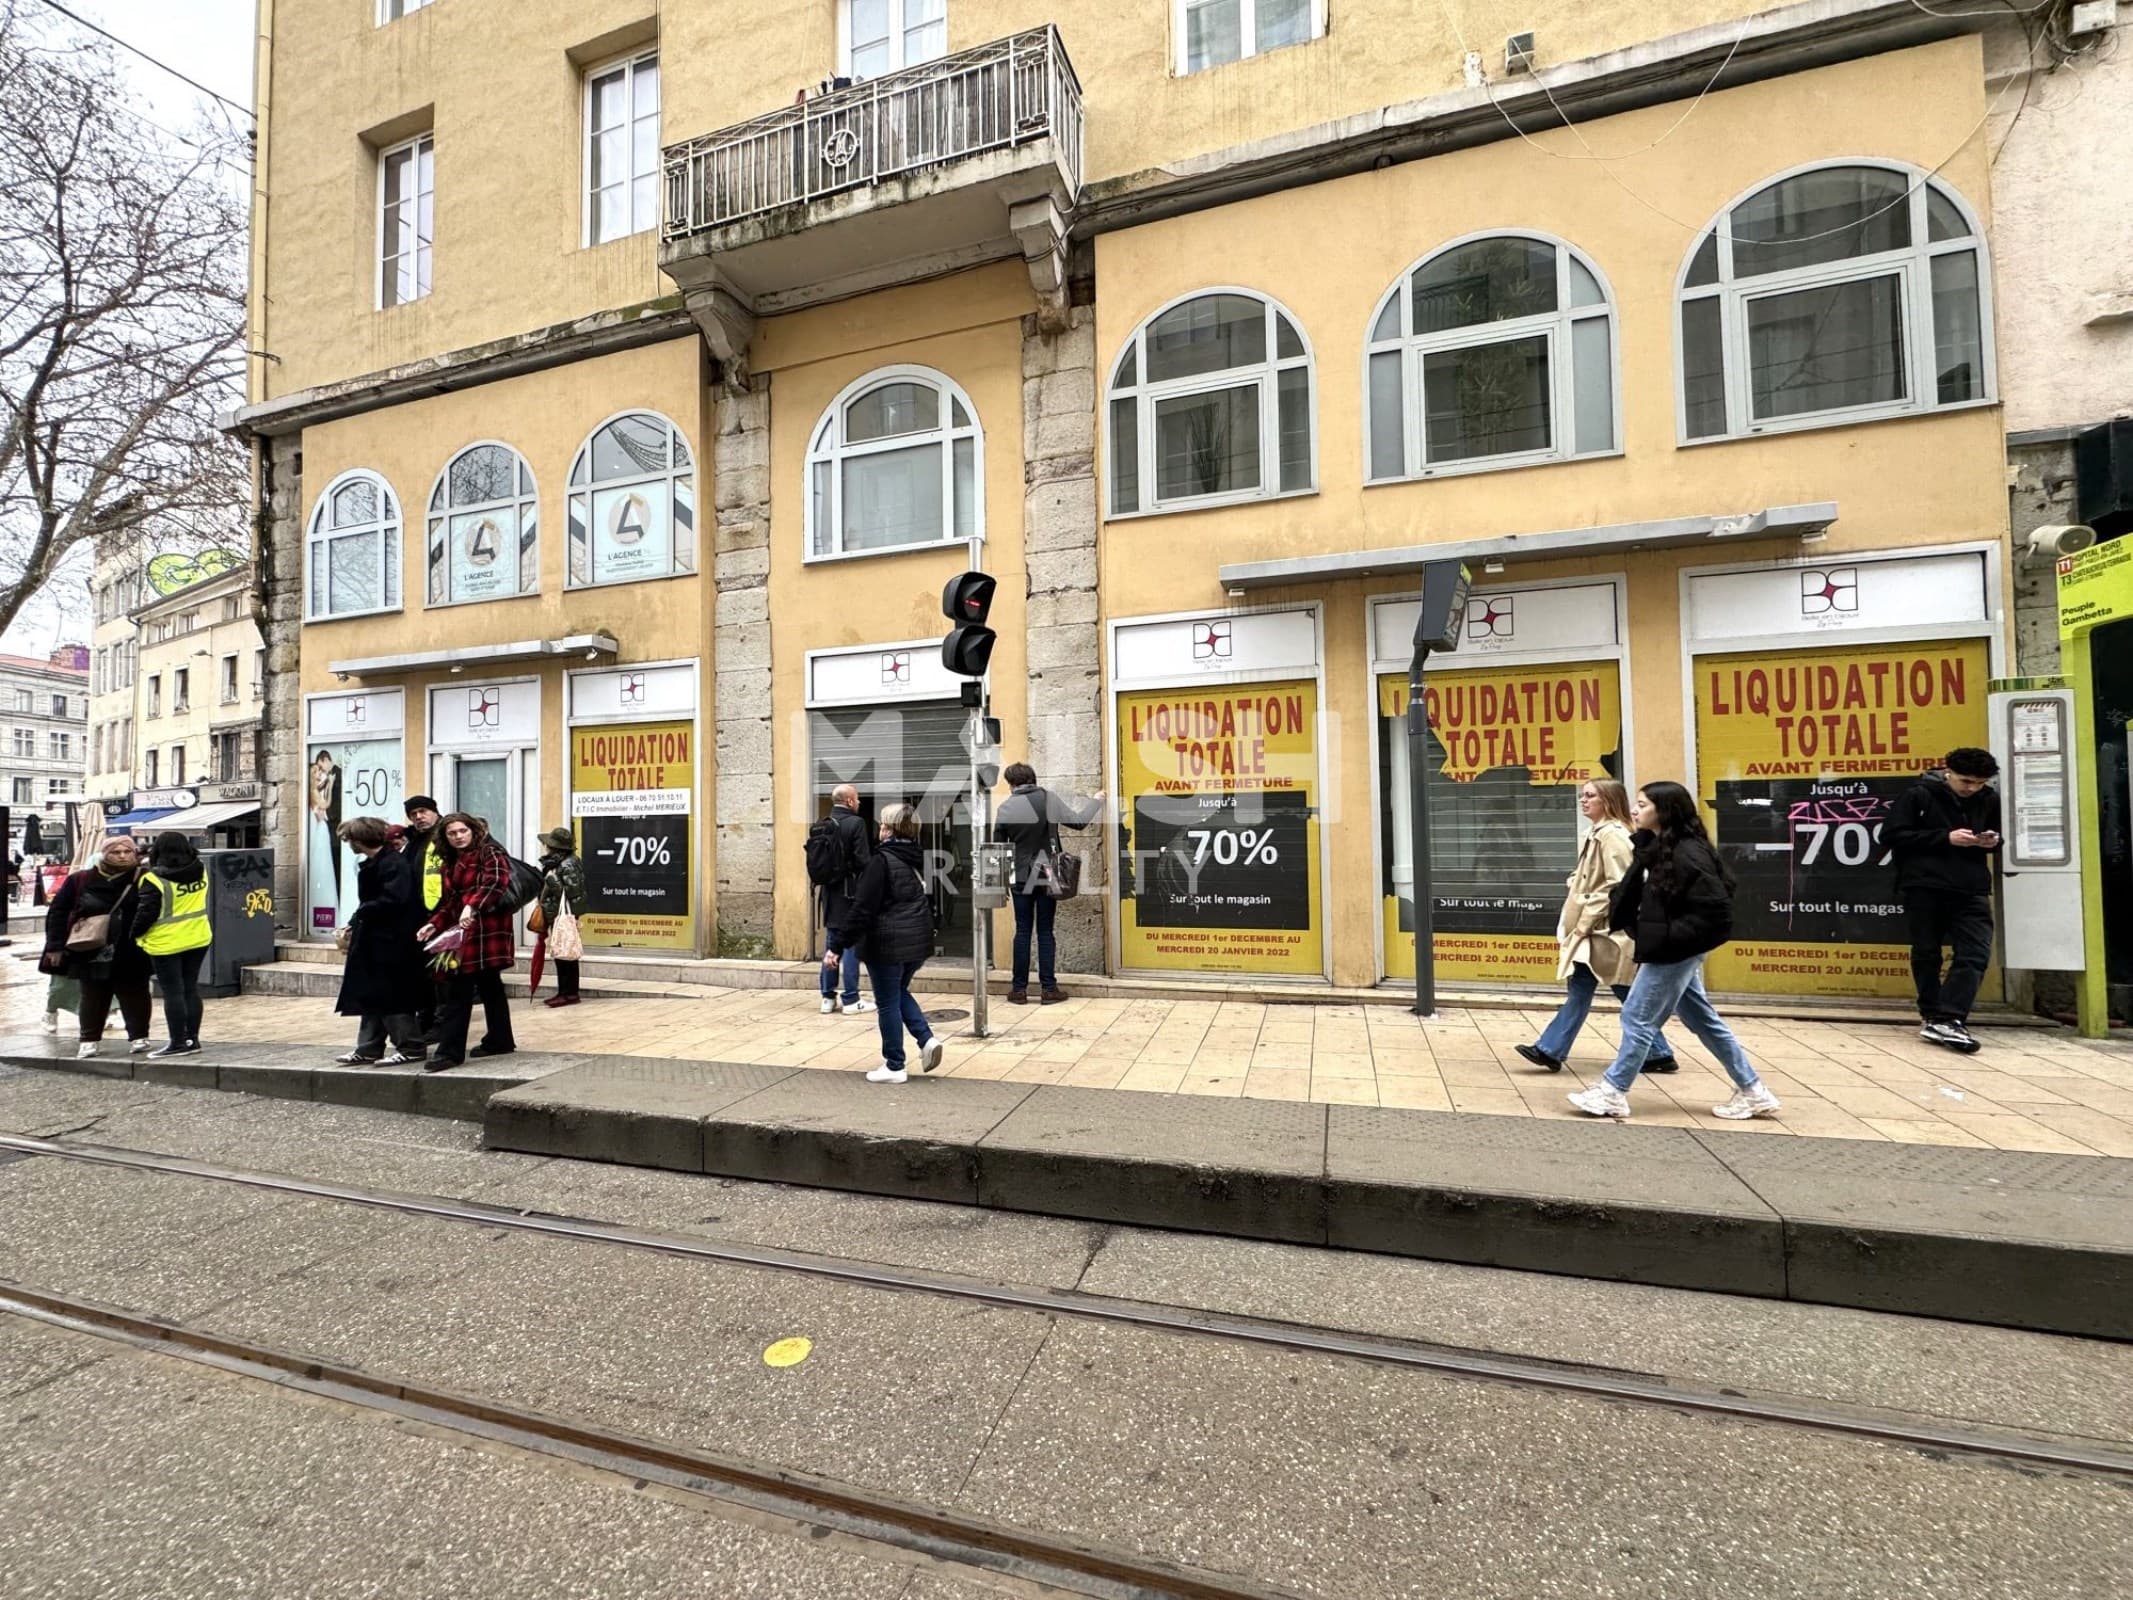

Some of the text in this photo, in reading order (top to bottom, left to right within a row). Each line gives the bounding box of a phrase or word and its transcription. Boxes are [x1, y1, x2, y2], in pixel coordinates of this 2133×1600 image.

[2062, 575, 2071, 586] T3
[2062, 607, 2113, 626] Gambetta
[1711, 658, 1965, 717] LIQUIDATION
[1131, 695, 1303, 744] LIQUIDATION
[1775, 712, 1910, 758] TOTALE
[581, 732, 688, 768] LIQUIDATION
[1446, 727, 1555, 768] TOTALE
[1174, 740, 1266, 777] TOTALE
[1745, 757, 1947, 776] AVANT FERMETURE
[608, 766, 664, 791] TOTALE
[1155, 776, 1293, 792] AVANT FERMETURE
[1809, 782, 1869, 798] Jusqu'à
[1198, 797, 1238, 810] Jusqu'à
[597, 836, 671, 866] -70%
[602, 887, 666, 897] Sur tout le magasin
[1214, 893, 1224, 904] le
[1226, 894, 1271, 907] magasin
[1769, 900, 1905, 916] Sur tout le magas
[640, 918, 673, 926] DECEMBRE
[594, 928, 625, 936] MERCREDI
[634, 928, 660, 937] JANVIER
[1146, 932, 1301, 944] DU MERCREDI 1er DECEMBRE AU
[1156, 945, 1290, 957] MERCREDI 20 JANVIER 2022
[1491, 941, 1510, 949] 1er
[1512, 942, 1561, 951] DECEMB
[1734, 947, 1910, 961] DU MERCREDI 1er DECEM
[1432, 953, 1482, 962] ERCREDI
[1485, 954, 1498, 963] 20
[1502, 954, 1553, 965] JANVIER
[1751, 963, 1909, 977] MERCREDI 20 JANVIER
